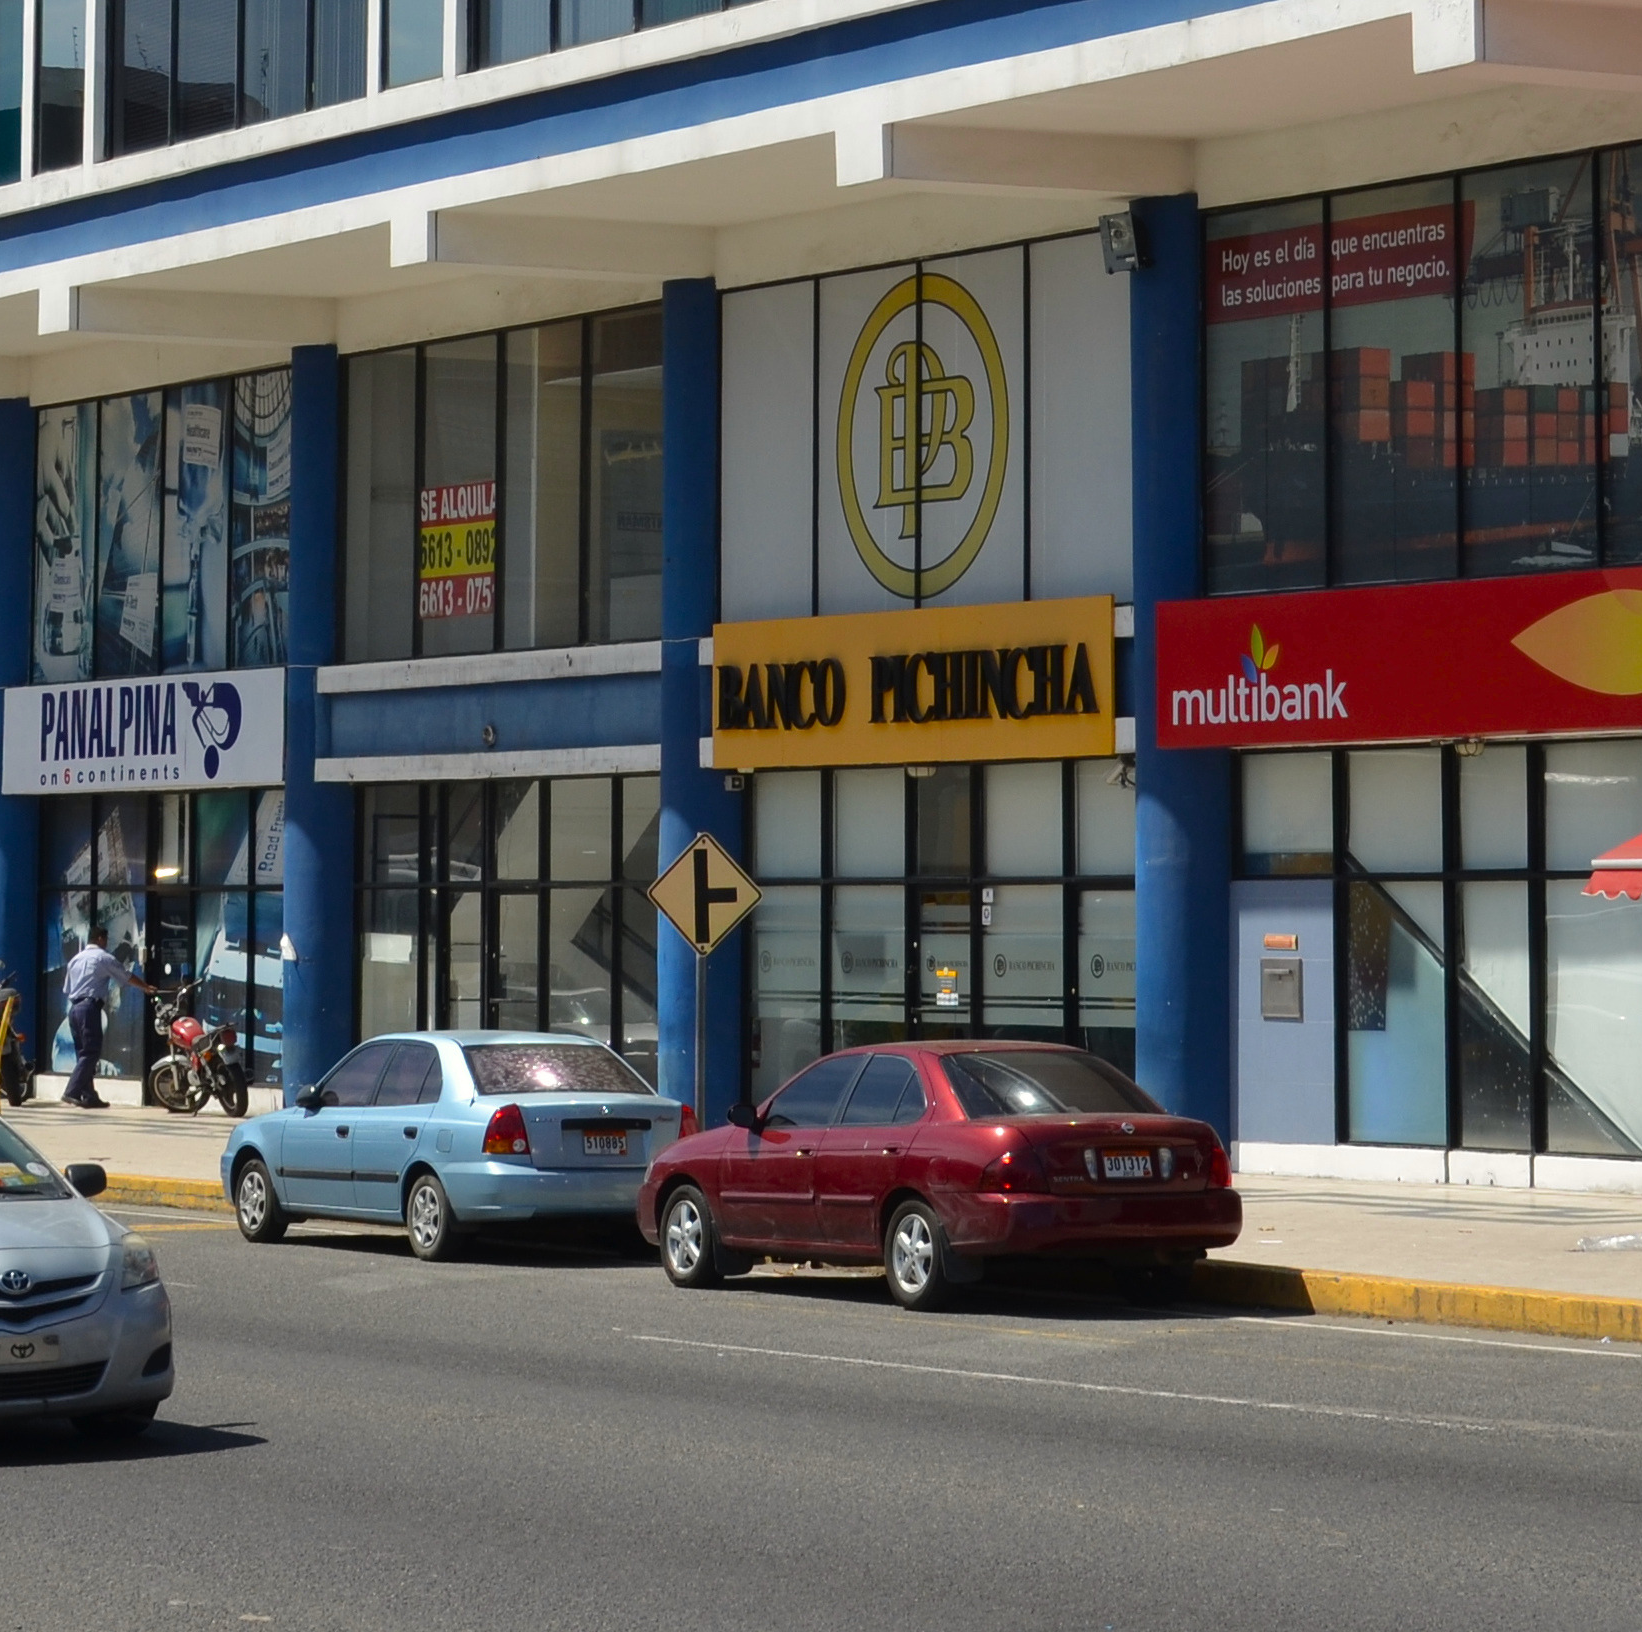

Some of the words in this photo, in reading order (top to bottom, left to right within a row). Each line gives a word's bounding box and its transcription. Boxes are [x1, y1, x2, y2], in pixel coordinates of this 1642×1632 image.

[1221, 250, 1250, 275] Hoy
[1254, 251, 1271, 267] es
[1275, 243, 1289, 264] el
[1293, 236, 1316, 260] día
[1331, 236, 1358, 260] que
[1362, 222, 1446, 251] encuentras
[1221, 284, 1242, 307] las
[1246, 276, 1321, 303] soluciones
[1331, 271, 1364, 297] para
[1368, 266, 1383, 284] tu
[1386, 255, 1450, 287] negocio.
[421, 490, 437, 522] SE
[441, 483, 496, 520] ALQUILA
[421, 531, 453, 570] 6613
[420, 579, 454, 617] 6613
[466, 576, 495, 614] 075
[716, 658, 846, 731] BANCO
[868, 642, 1100, 724] PICHINCHA
[1172, 669, 1348, 725] multibank
[41, 683, 176, 761] PANALPINA
[40, 773, 57, 786] on
[63, 768, 71, 785] 6
[77, 765, 179, 784] continents
[258, 835, 280, 872] Road
[1108, 1157, 1148, 1172] 301312
